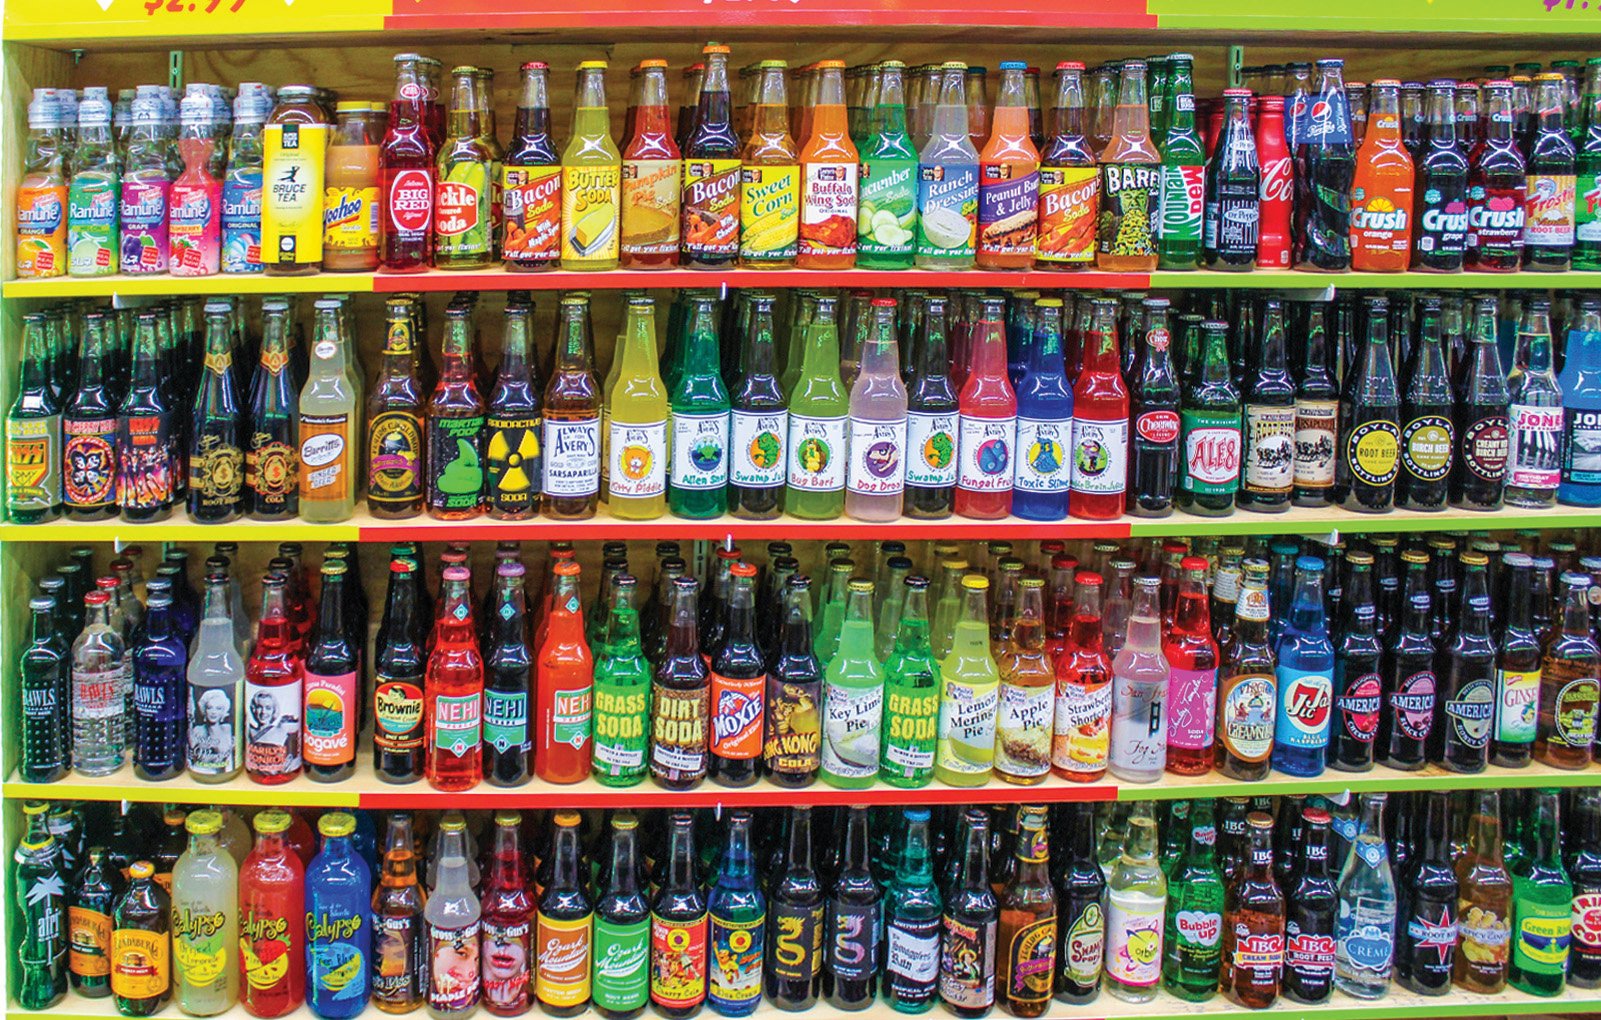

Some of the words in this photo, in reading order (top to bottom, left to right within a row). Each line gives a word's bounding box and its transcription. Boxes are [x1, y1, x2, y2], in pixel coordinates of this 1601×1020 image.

[273, 184, 305, 193] BRUCE
[746, 174, 791, 204] Sweet
[812, 182, 853, 195] Buffalo
[859, 167, 911, 198] ucumber
[928, 170, 974, 198] Ranch
[277, 193, 297, 202] TEA
[397, 190, 428, 200] BIG
[439, 186, 475, 206] ckle
[511, 174, 561, 211] Bacon
[575, 189, 612, 211] SODA
[633, 190, 655, 206] Pie
[986, 184, 1022, 205] Peanut
[1045, 181, 1097, 216] Bacon
[394, 200, 430, 210] RED
[526, 198, 554, 219] Soda
[752, 193, 793, 218] Corn
[805, 195, 834, 209] Wing
[996, 204, 1006, 216] &
[1008, 195, 1033, 214] Jelly
[1063, 204, 1090, 222] Soda
[1352, 208, 1407, 230] Crush
[1423, 208, 1468, 231] Crus
[1469, 206, 1524, 229] Crush
[439, 216, 467, 232] oda
[1363, 231, 1393, 240] orange
[1442, 232, 1463, 242] grape
[1478, 229, 1519, 239] strawberry
[1466, 418, 1509, 440] BOYL
[1359, 447, 1379, 458] ROOT
[1412, 442, 1433, 453] BIRCH
[735, 470, 770, 483] Swamp
[791, 473, 808, 487] Bug
[811, 476, 834, 487] Barf
[908, 470, 943, 483] Swamp
[962, 476, 995, 489] Fungal
[1019, 476, 1044, 488] Toxic
[857, 479, 876, 492] Dog
[500, 493, 528, 502] SODA
[377, 696, 421, 715] Brownie
[485, 699, 524, 718] NEHI
[557, 696, 592, 715] NEH
[595, 691, 646, 715] GRASS
[659, 696, 701, 719] DIRT
[829, 707, 852, 722] Key
[855, 697, 882, 716] Lime
[888, 693, 939, 717] GRASS
[957, 694, 997, 715] Lemon
[1010, 700, 1049, 721] Apple
[438, 702, 479, 722] NEHI
[596, 715, 643, 739] SODA
[713, 695, 763, 748] MOXIE
[846, 720, 867, 733] Pie
[890, 716, 938, 741] SODA
[1023, 718, 1044, 731] Pie
[655, 719, 702, 745] SODA
[963, 726, 985, 740] Pie
[784, 733, 818, 756] KONG
[778, 757, 812, 768] COLA
[1224, 820, 1246, 831] IBC
[1253, 850, 1273, 861] IBC
[1306, 845, 1328, 856] IBC
[306, 911, 362, 943] Calypso
[506, 925, 530, 938] Gus's
[1179, 918, 1217, 932] Bubble
[1524, 921, 1554, 935] Green
[1197, 928, 1217, 940] up
[1421, 929, 1448, 938] ROOT
[547, 933, 585, 956] Ozark
[607, 938, 644, 962] Ozark
[1252, 939, 1278, 952] IBC
[1302, 939, 1329, 952] IBC
[1294, 952, 1315, 961] ROOT
